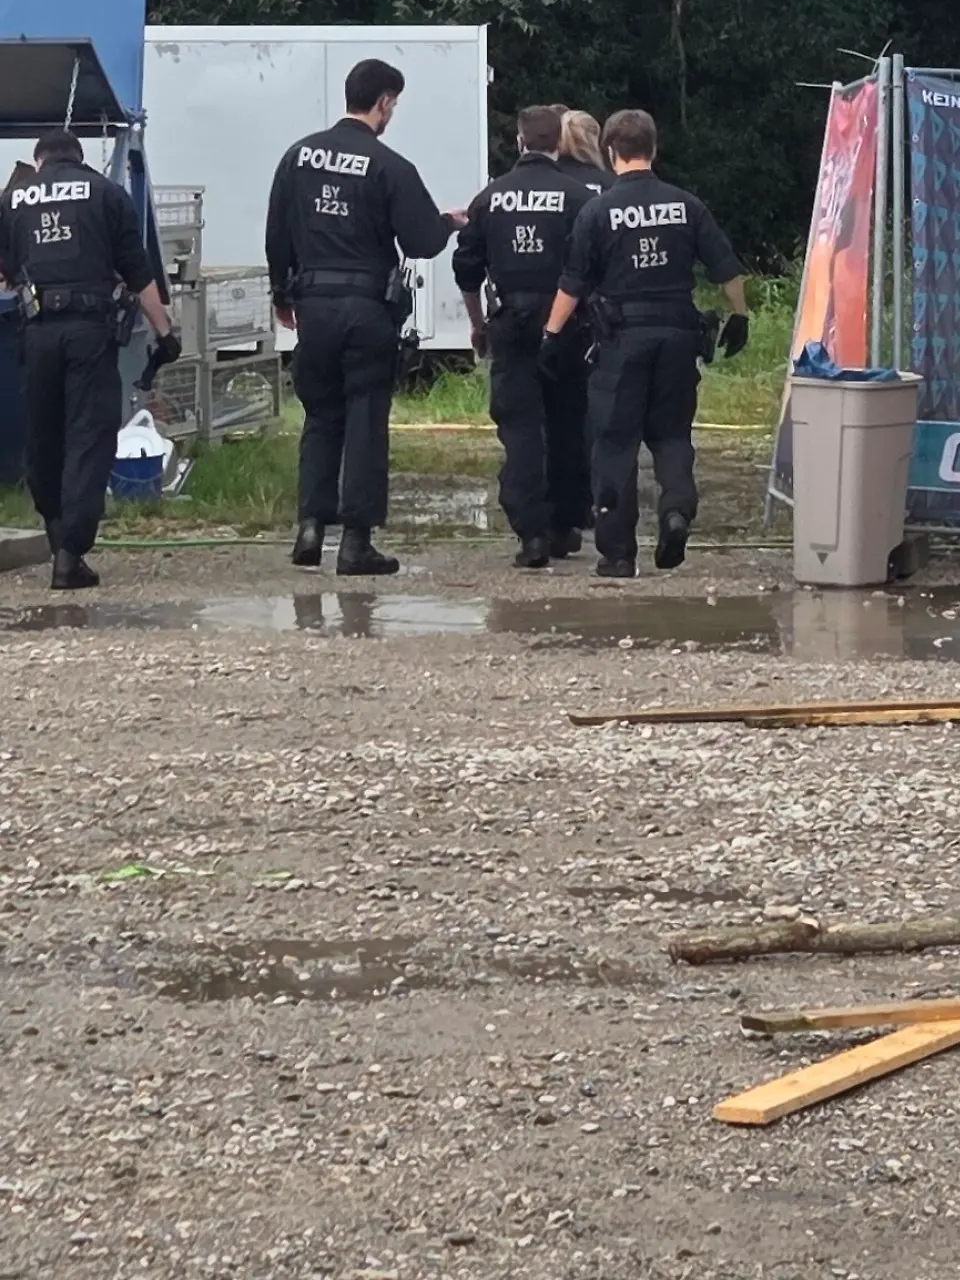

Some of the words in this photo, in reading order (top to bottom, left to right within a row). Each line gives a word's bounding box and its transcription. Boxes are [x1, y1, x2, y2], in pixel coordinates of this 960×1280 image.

[297, 146, 371, 176] POLIZEI
[11, 181, 90, 209] POLIZEI
[322, 184, 340, 199] BY
[314, 198, 349, 216] 1223
[489, 190, 565, 212] POLIZEI
[41, 211, 60, 228] BY
[609, 202, 688, 230] POLIZEI
[33, 225, 72, 244] 1223
[515, 225, 537, 241] BY
[512, 238, 544, 254] 1223
[639, 237, 660, 253] BY
[631, 251, 669, 269] 1223
